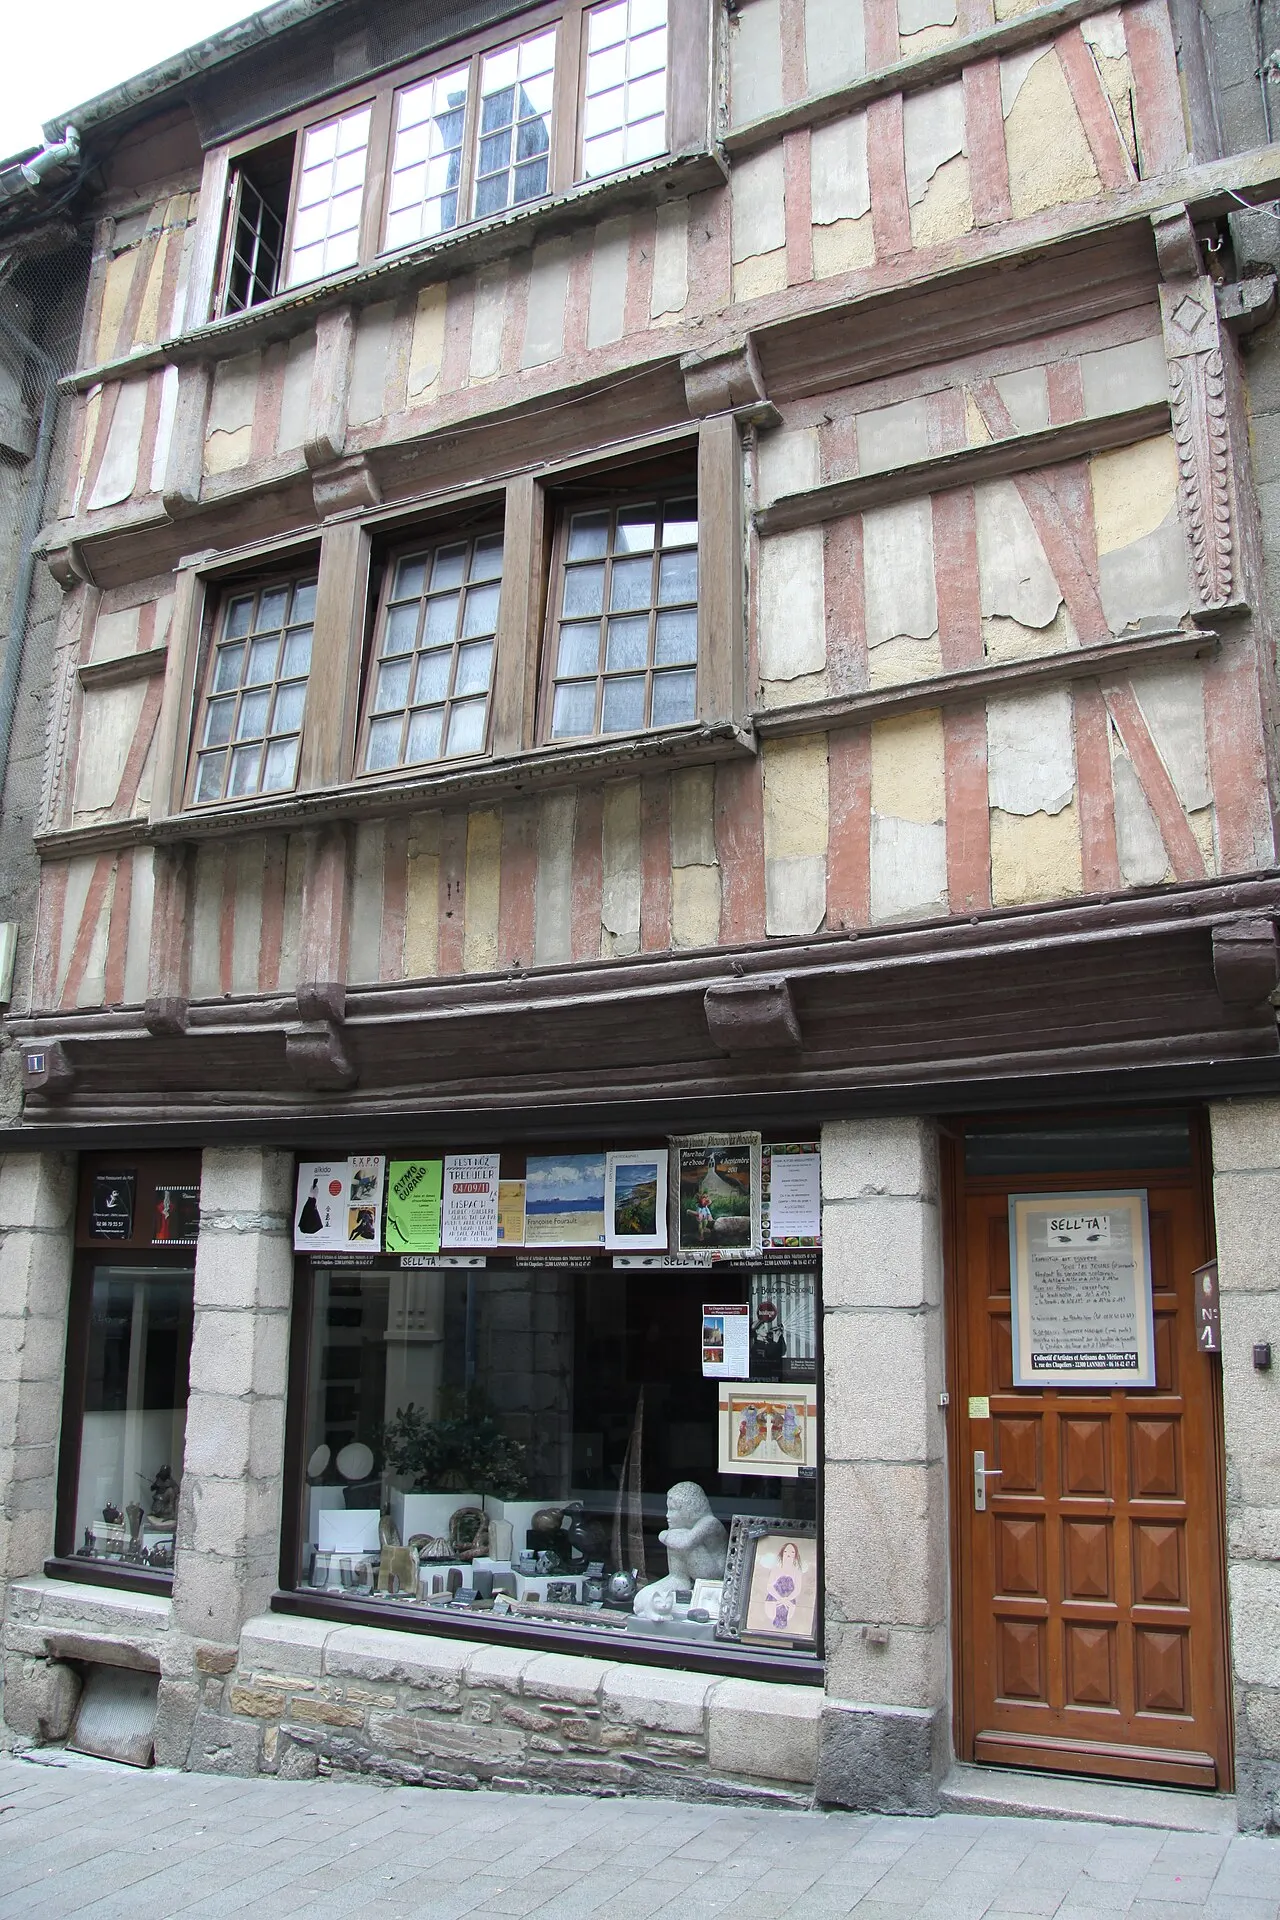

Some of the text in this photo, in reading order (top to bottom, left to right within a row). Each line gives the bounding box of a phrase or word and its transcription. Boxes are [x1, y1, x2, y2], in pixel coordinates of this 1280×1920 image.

[352, 1156, 380, 1164] EXPO
[394, 1166, 417, 1194] RITMO
[399, 1167, 427, 1201] CUBANO
[453, 1184, 488, 1193] 24/09/11
[527, 1218, 553, 1226] Françoise
[1050, 1217, 1100, 1231] SELL'TA
[402, 1256, 436, 1266] SELL'TA
[663, 1256, 704, 1266] SELLTA
[1201, 1325, 1216, 1348] 1
